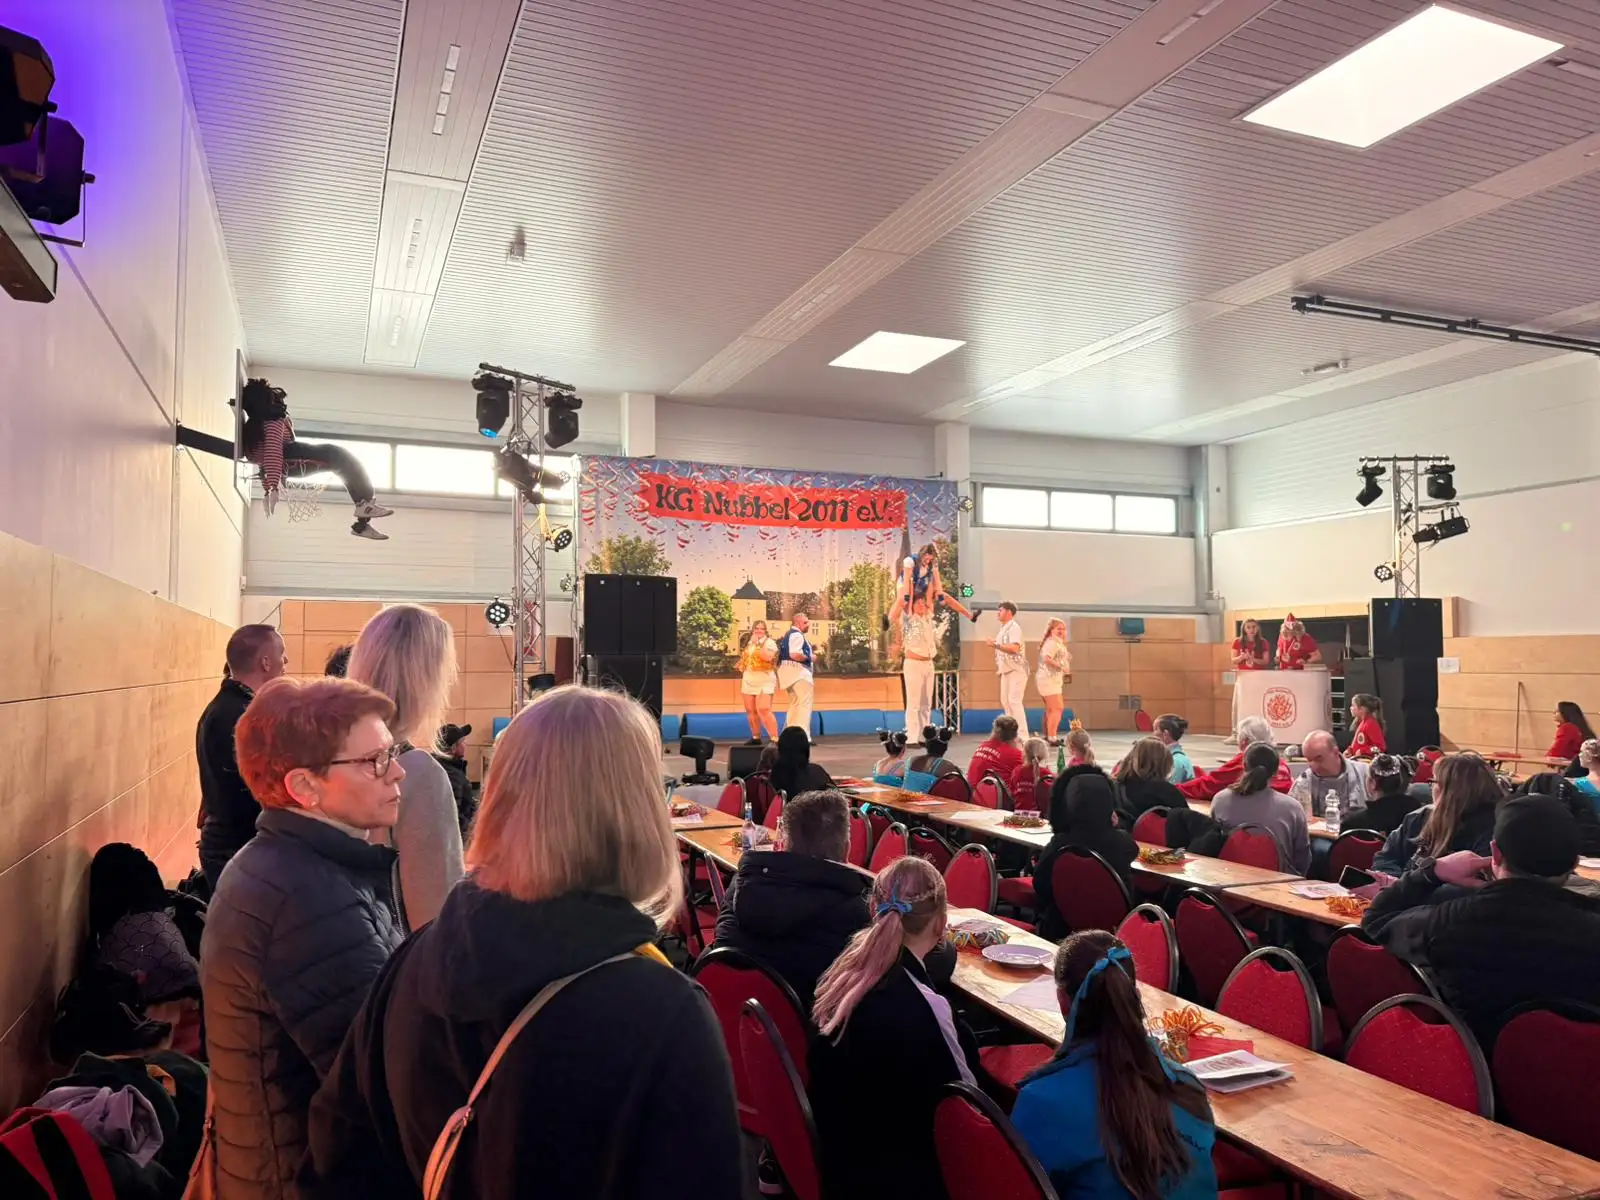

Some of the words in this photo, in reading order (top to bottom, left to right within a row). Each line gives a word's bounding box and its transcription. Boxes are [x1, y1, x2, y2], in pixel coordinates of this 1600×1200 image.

[656, 483, 694, 512] KG
[703, 490, 790, 520] Nubbel
[798, 498, 849, 522] 2011
